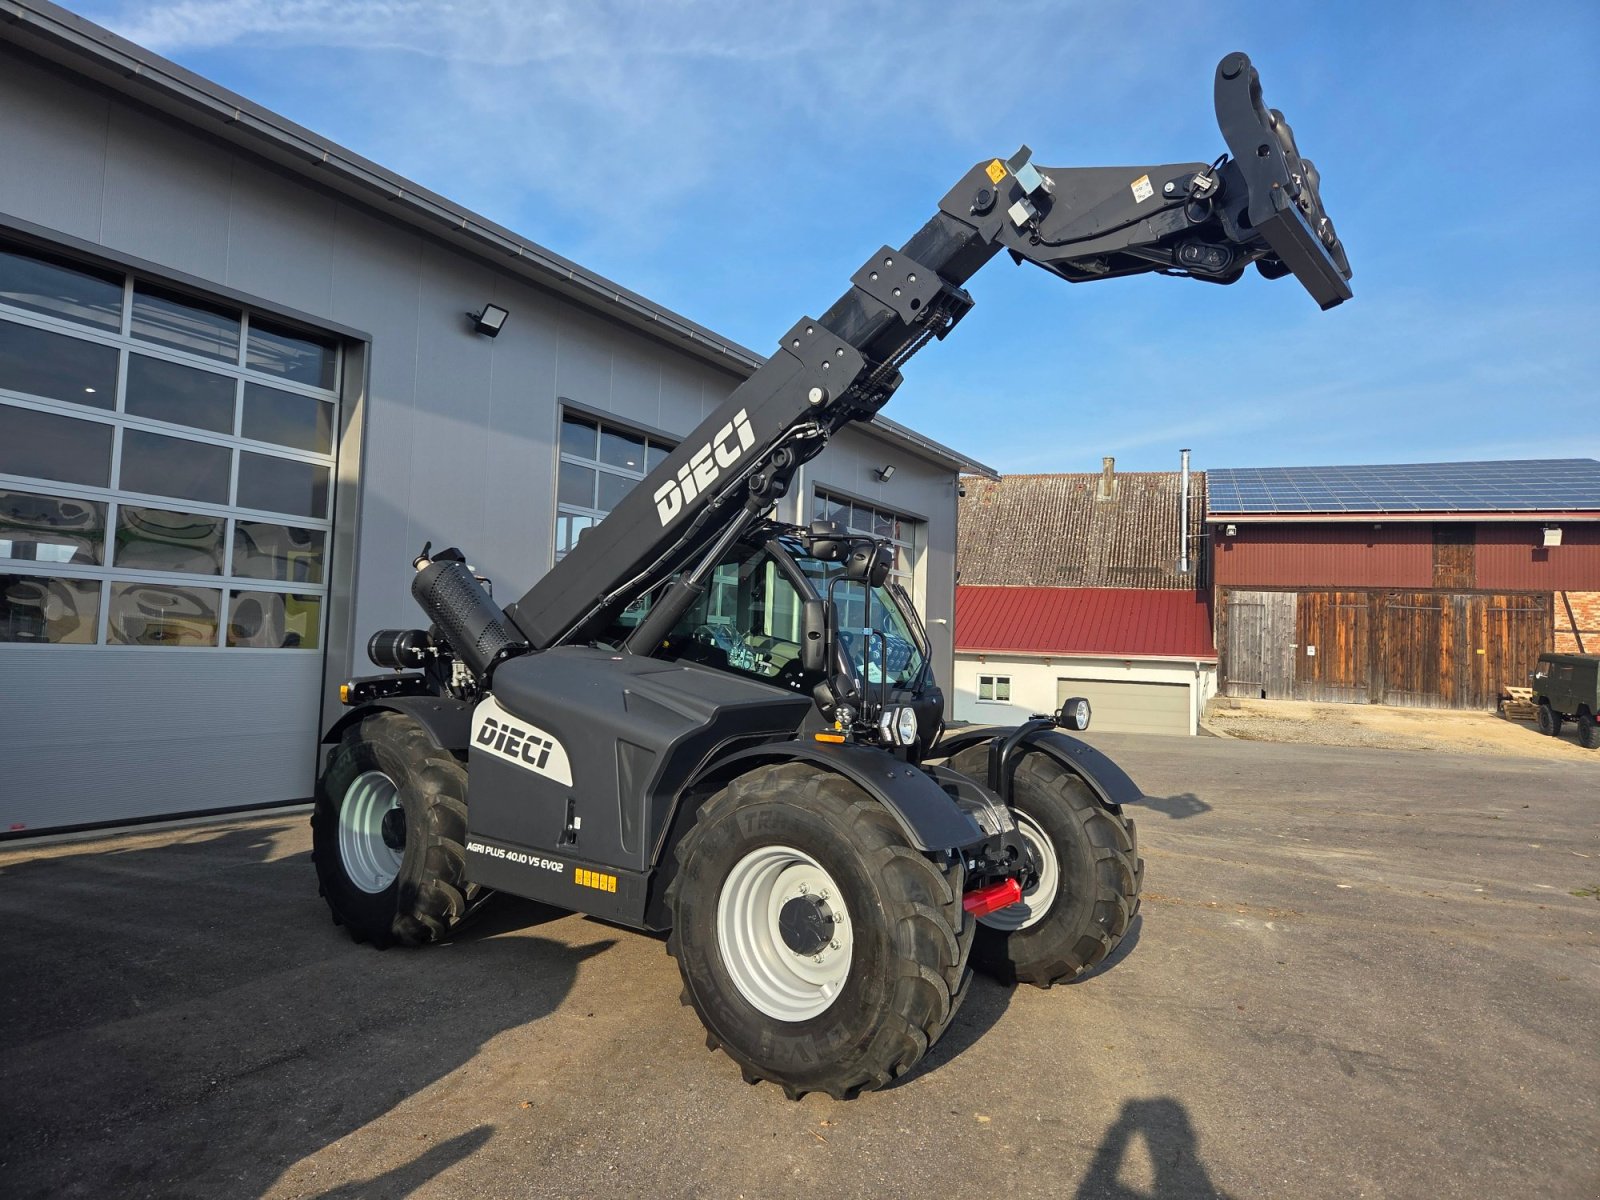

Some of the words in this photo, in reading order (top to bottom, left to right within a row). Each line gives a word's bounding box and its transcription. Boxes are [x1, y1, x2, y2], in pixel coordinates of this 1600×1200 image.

[466, 842, 485, 854] AGRI
[485, 846, 506, 859] PLUS
[506, 851, 528, 865] 40.10
[540, 860, 564, 873] EVO2
